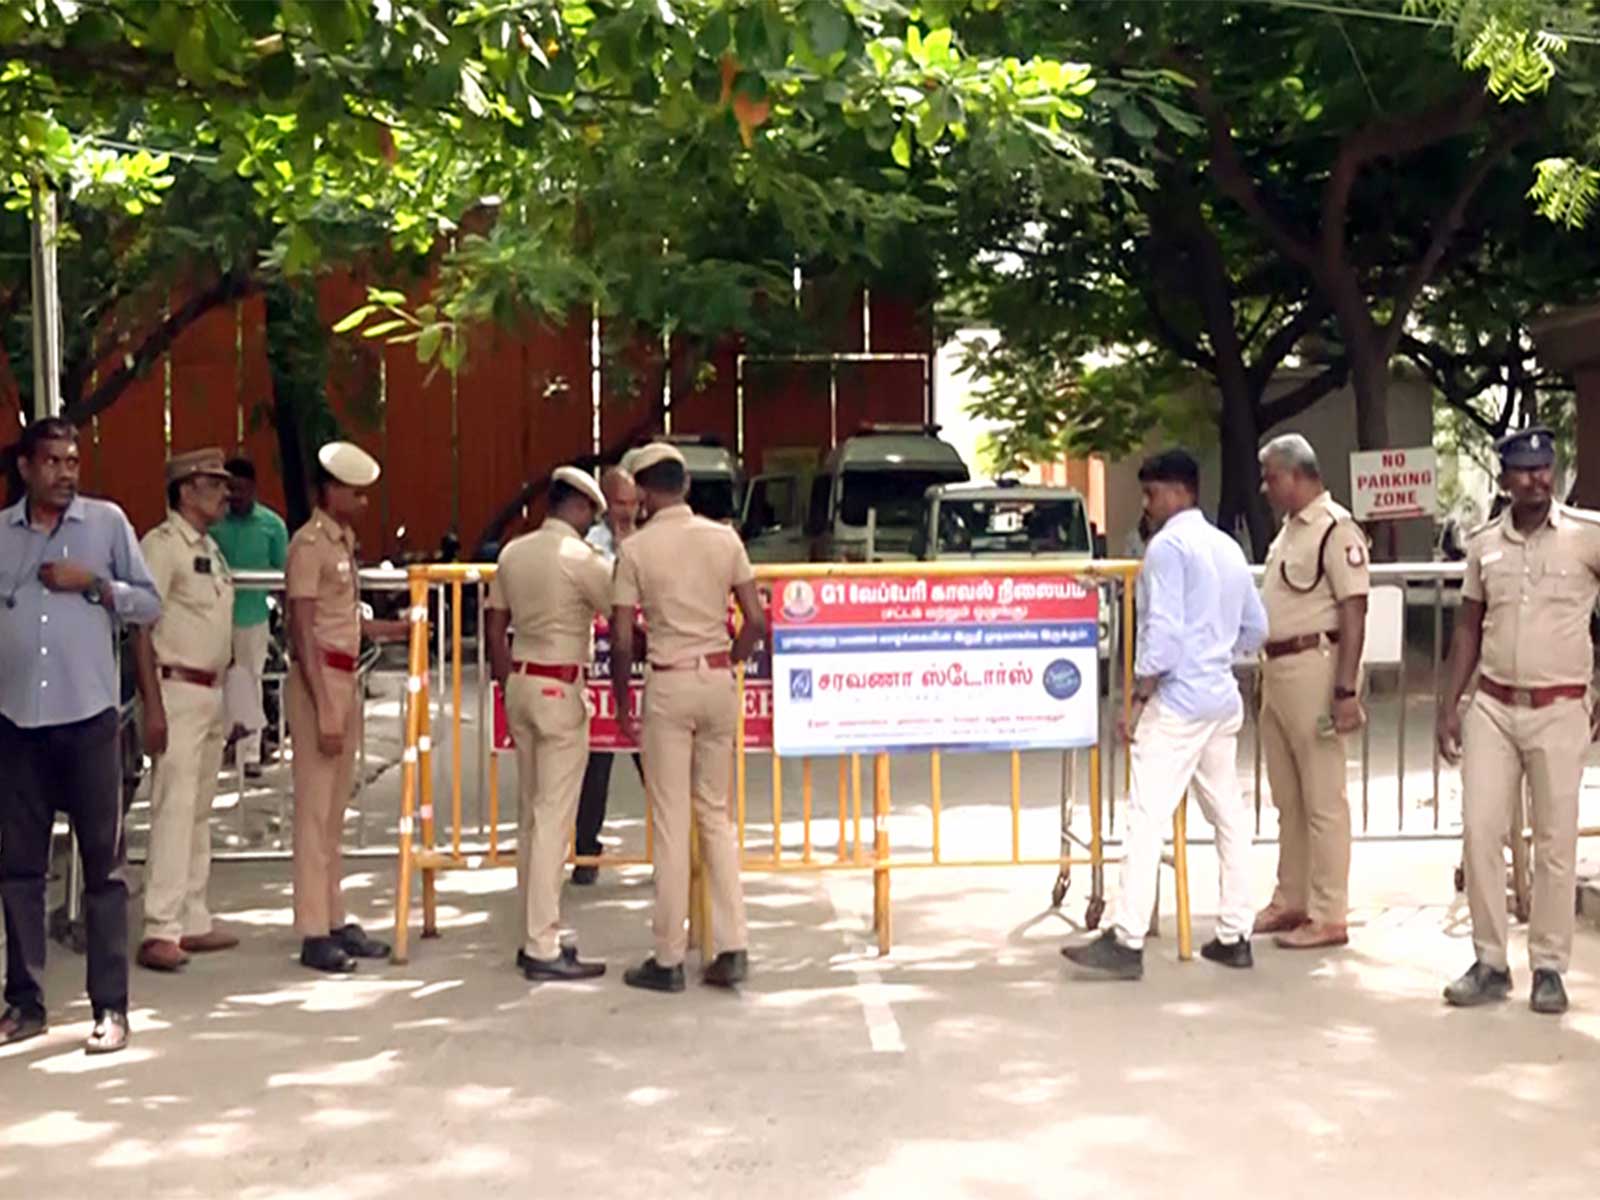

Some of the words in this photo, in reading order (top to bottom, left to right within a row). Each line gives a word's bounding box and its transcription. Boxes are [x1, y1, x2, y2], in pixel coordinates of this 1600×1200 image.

[1382, 453, 1406, 468] NO
[1357, 470, 1432, 490] PARKING
[1374, 491, 1416, 507] ZONE
[820, 583, 845, 604] G1
[931, 579, 994, 603] காவல்
[818, 671, 913, 692] சரவணா
[921, 660, 1034, 688] ஸ்டோர்ஸ்
